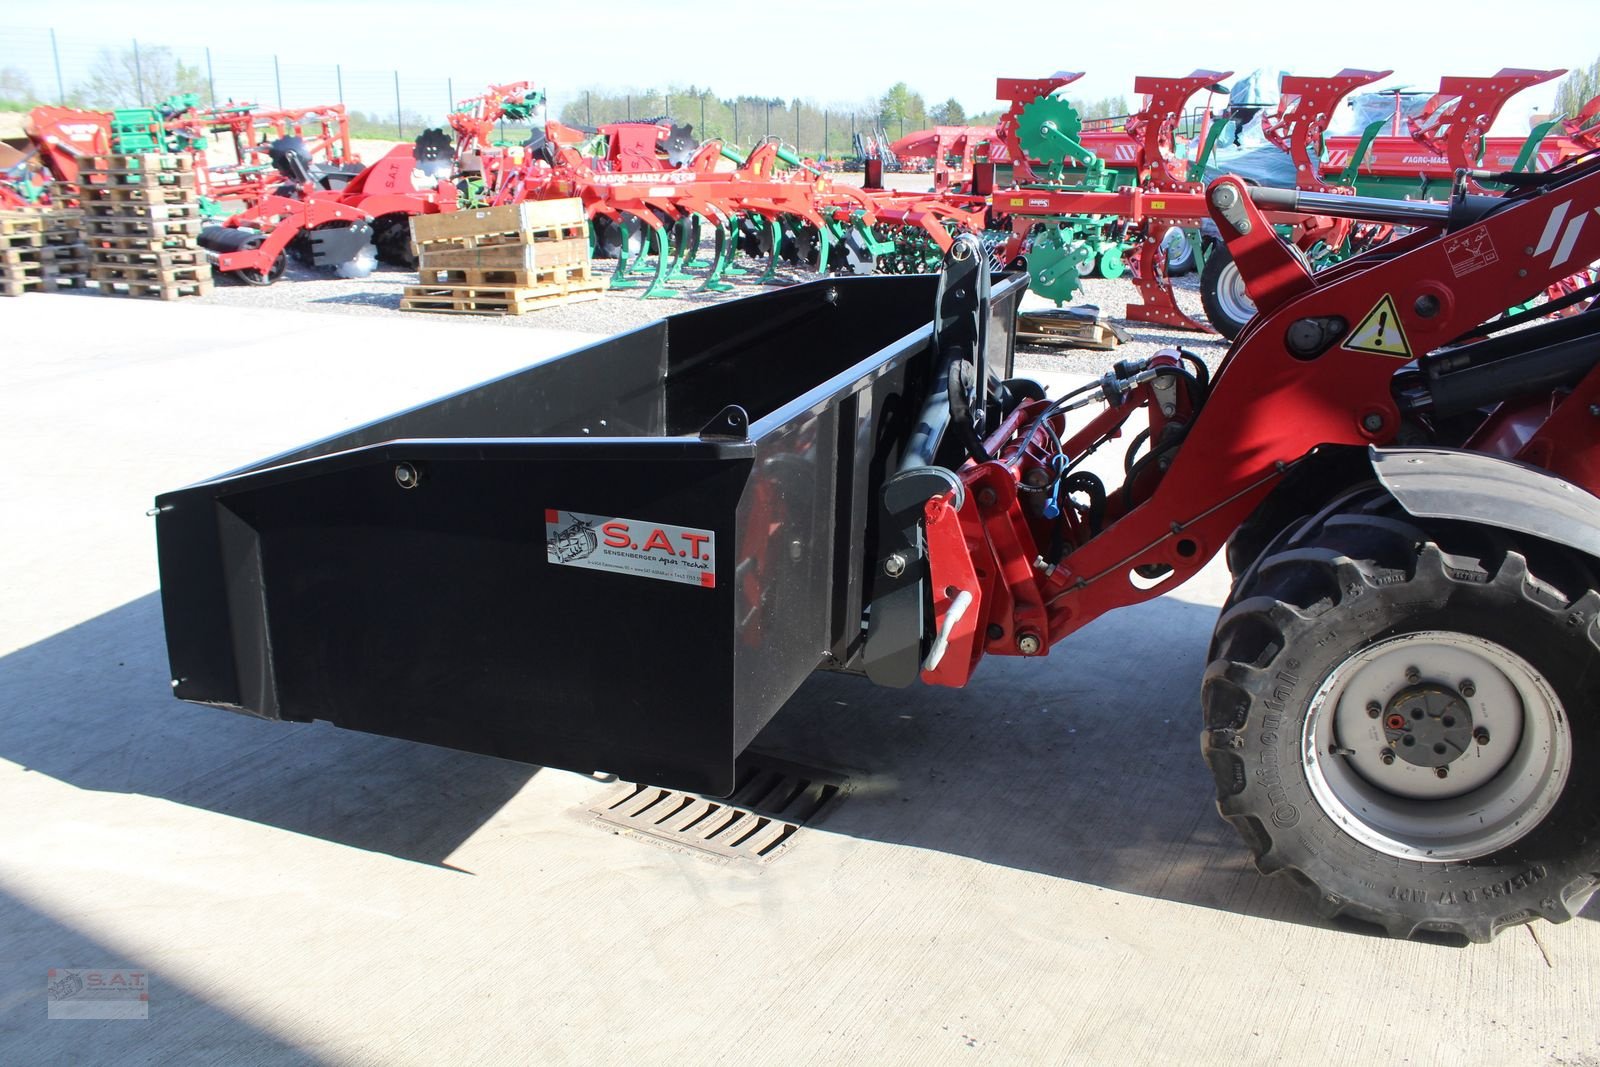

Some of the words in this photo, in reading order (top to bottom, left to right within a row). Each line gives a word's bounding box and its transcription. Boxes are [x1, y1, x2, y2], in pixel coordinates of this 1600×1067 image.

[602, 522, 710, 560] S.A.T.
[603, 549, 657, 561] SENSENBERGER
[682, 560, 710, 570] Technik
[1256, 669, 1302, 829] Continental
